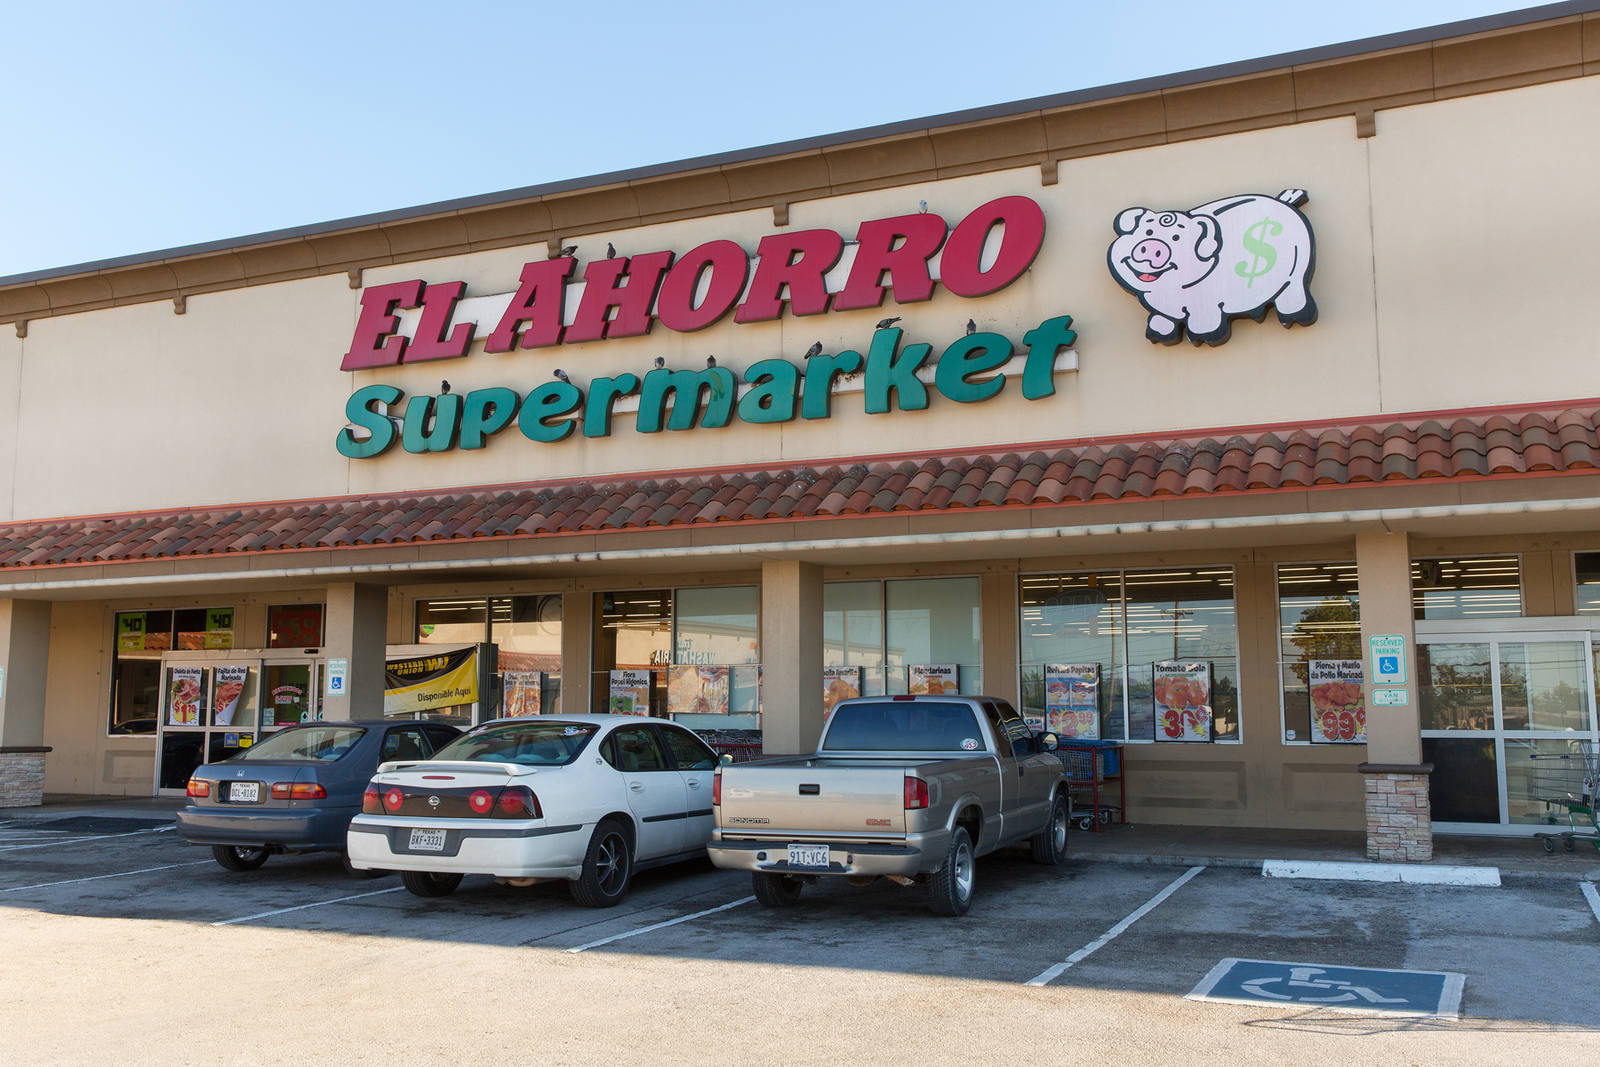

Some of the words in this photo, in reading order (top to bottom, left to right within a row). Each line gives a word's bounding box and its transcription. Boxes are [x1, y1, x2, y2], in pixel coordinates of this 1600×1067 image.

[340, 279, 478, 372] EL
[484, 194, 1047, 353] AHORRO
[336, 315, 1078, 459] Supermarket
[1372, 639, 1403, 647] RESERVED
[387, 660, 424, 671] WESTERN
[397, 667, 424, 676] UNION
[418, 689, 453, 703] Disponible
[865, 818, 892, 826] GMC
